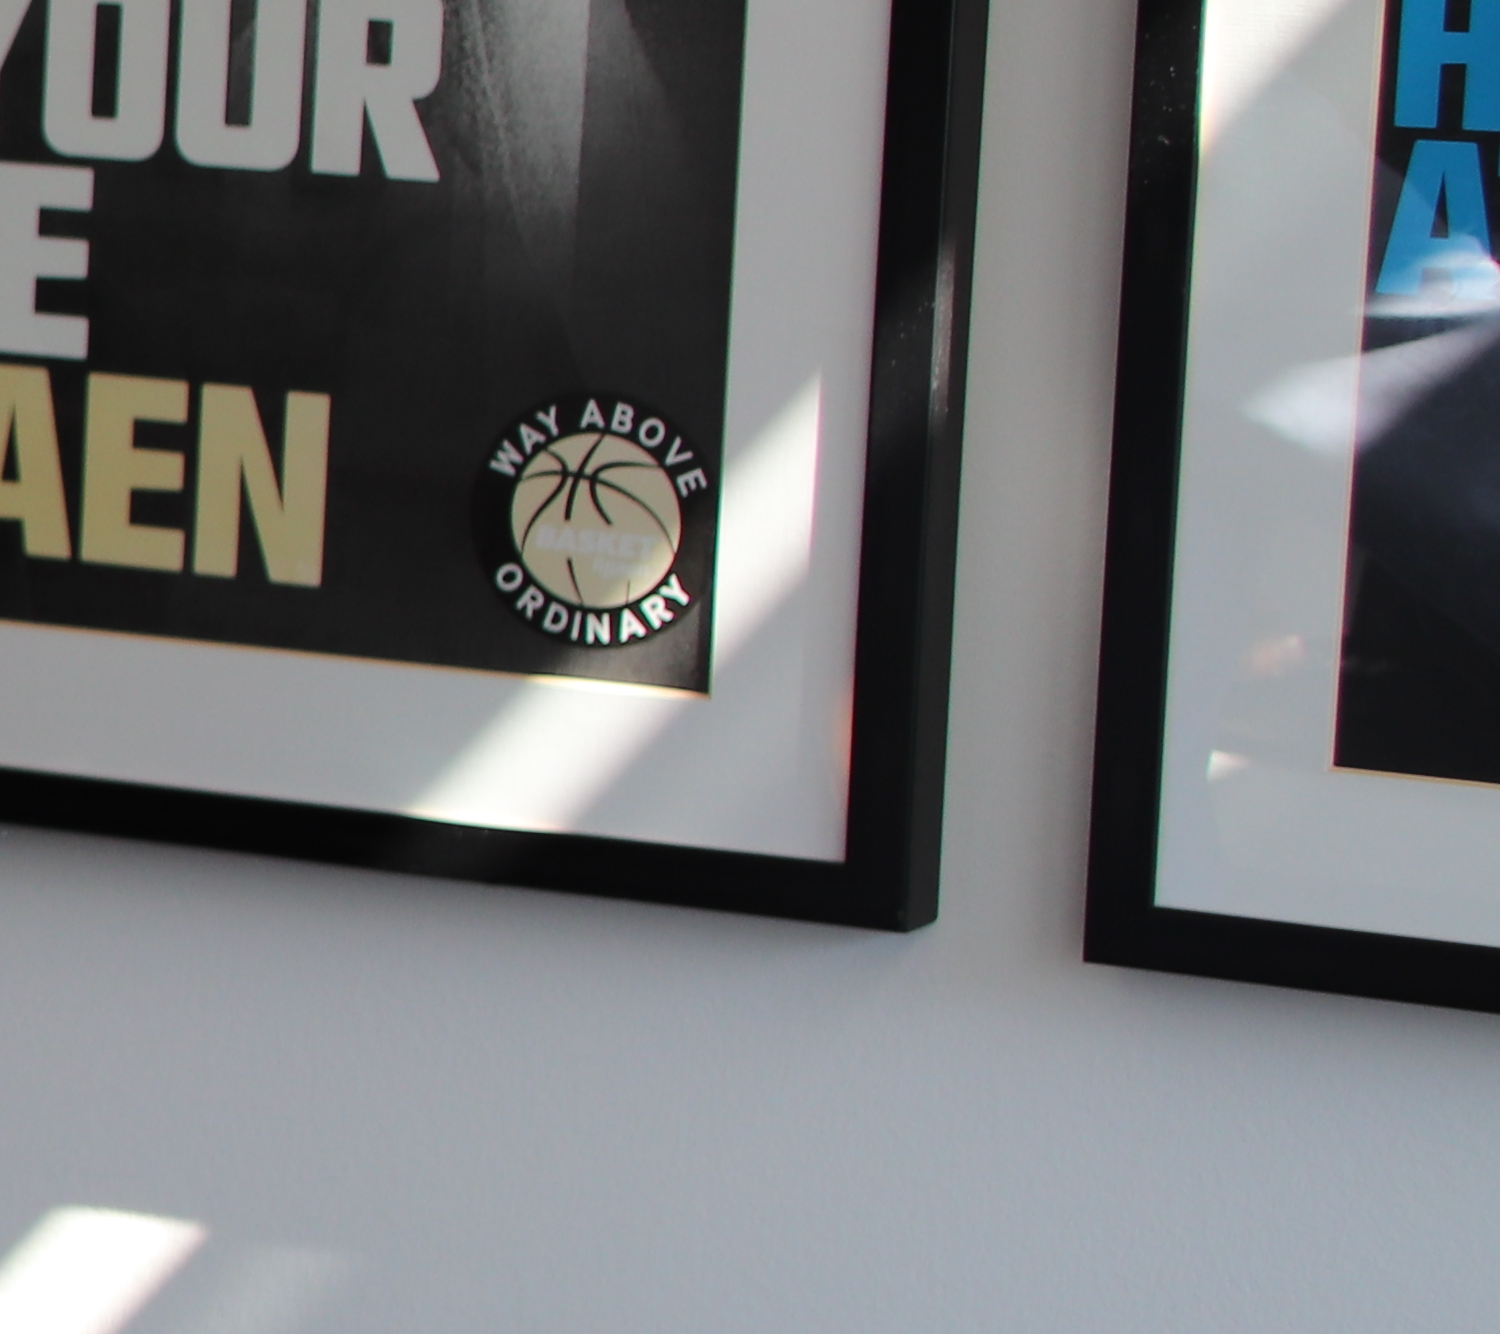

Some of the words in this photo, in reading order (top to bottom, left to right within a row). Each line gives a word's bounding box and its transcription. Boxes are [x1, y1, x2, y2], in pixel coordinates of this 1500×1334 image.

[489, 405, 559, 477] WAY
[580, 398, 708, 497] ABOVE
[495, 563, 693, 645] ORDINARY
